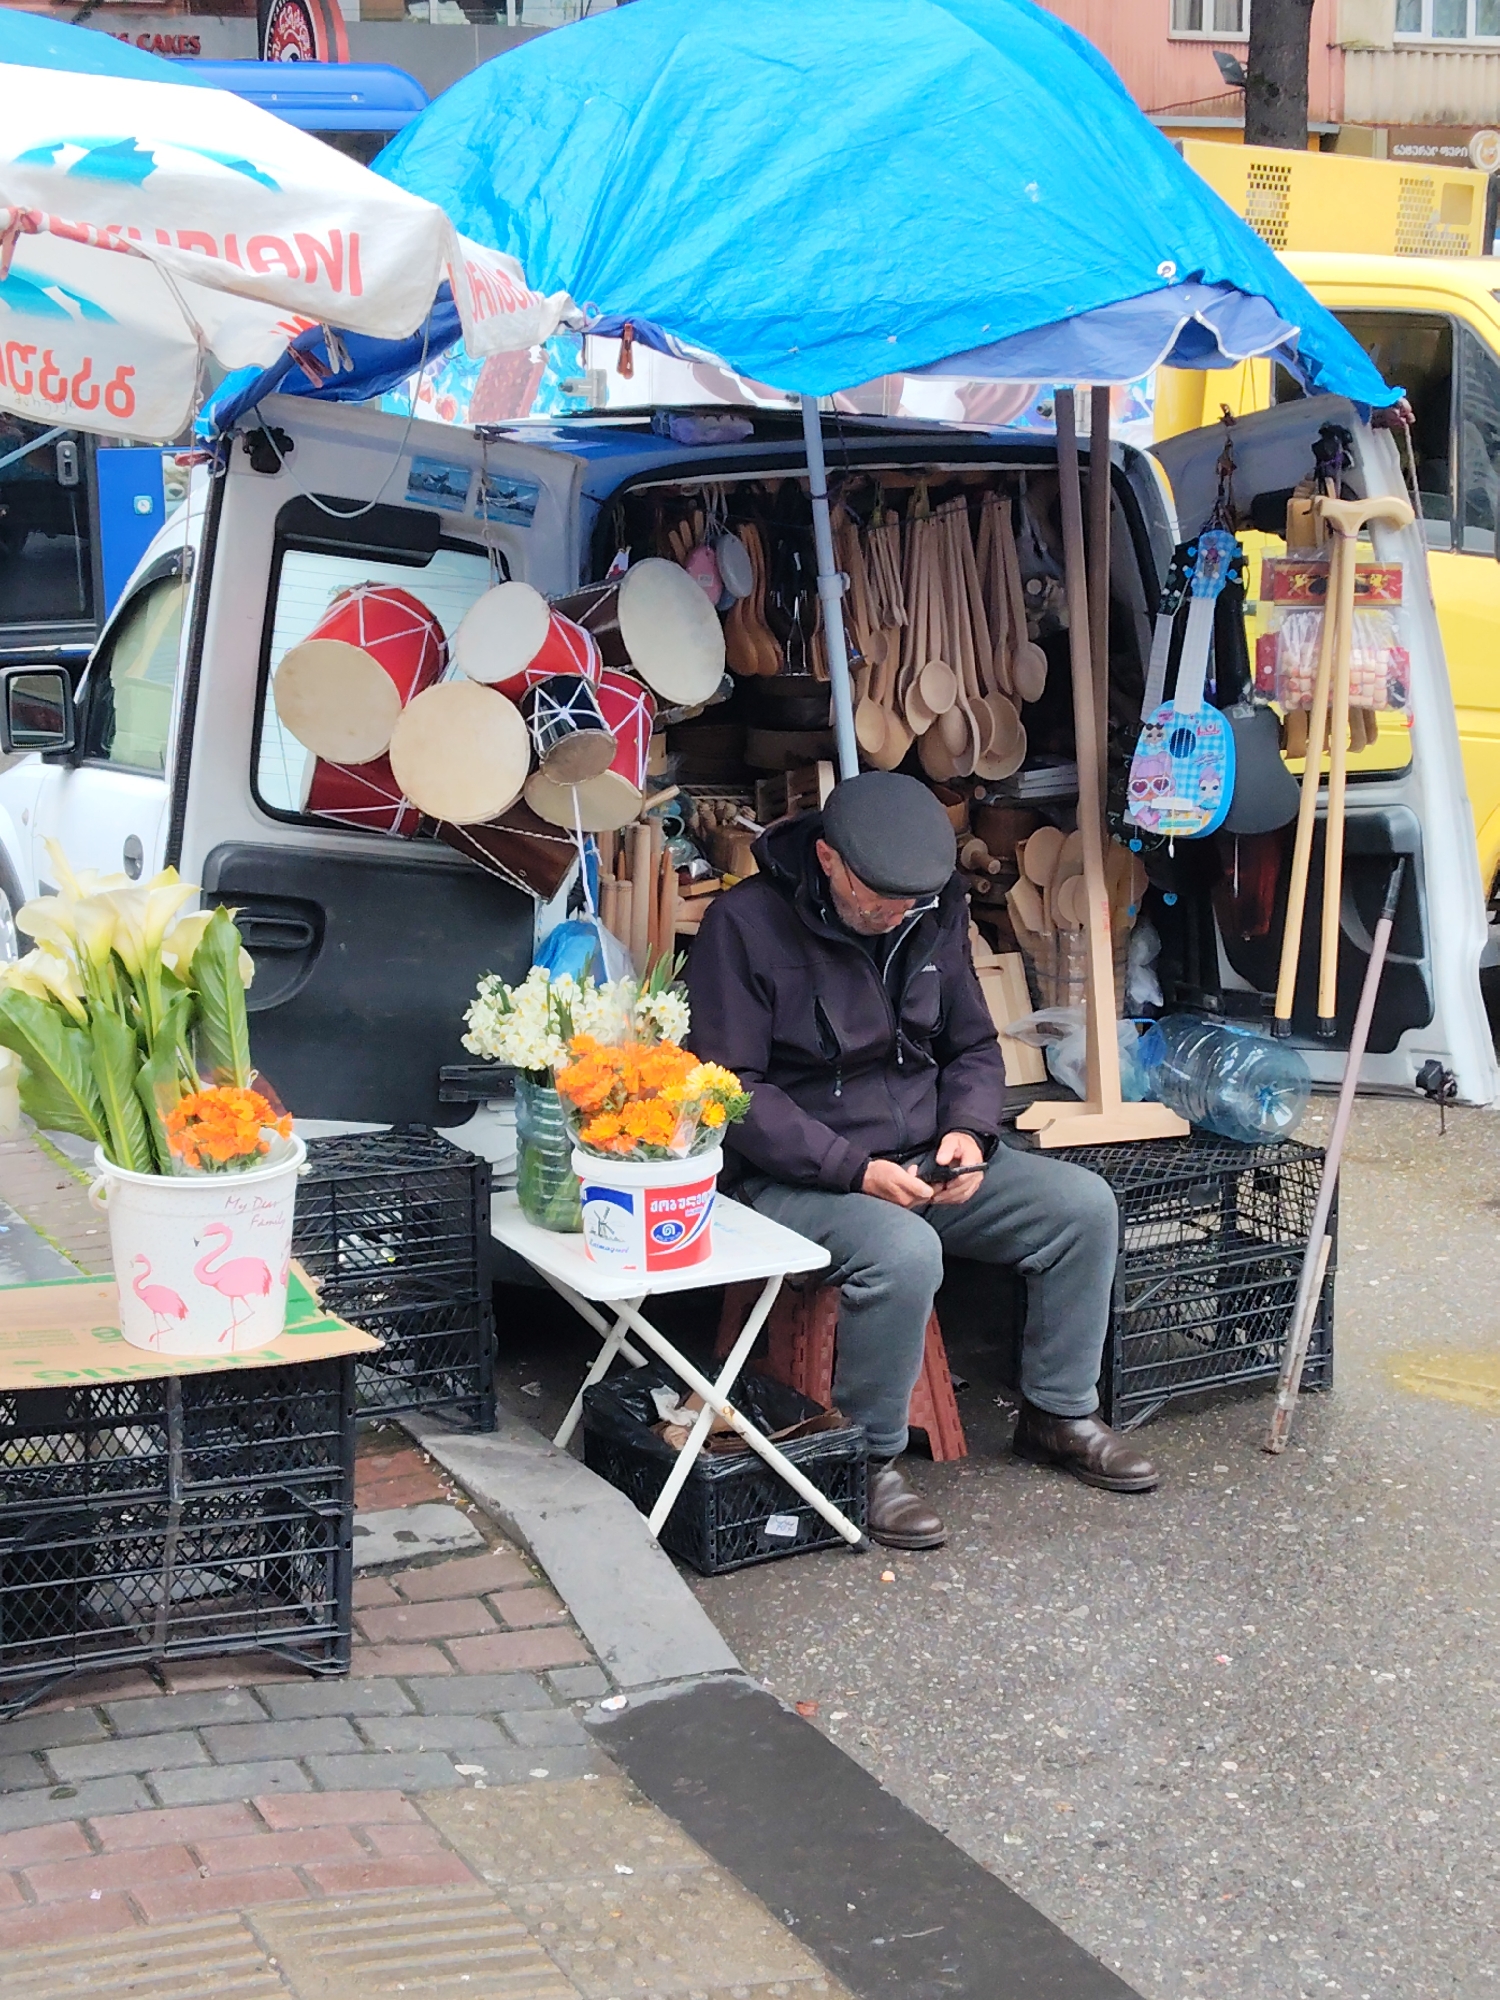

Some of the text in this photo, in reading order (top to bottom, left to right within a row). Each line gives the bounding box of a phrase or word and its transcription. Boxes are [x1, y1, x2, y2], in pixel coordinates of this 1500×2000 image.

[136, 33, 202, 55] CAKES
[224, 1195, 278, 1216] My Dear
[249, 1210, 287, 1231] Family
